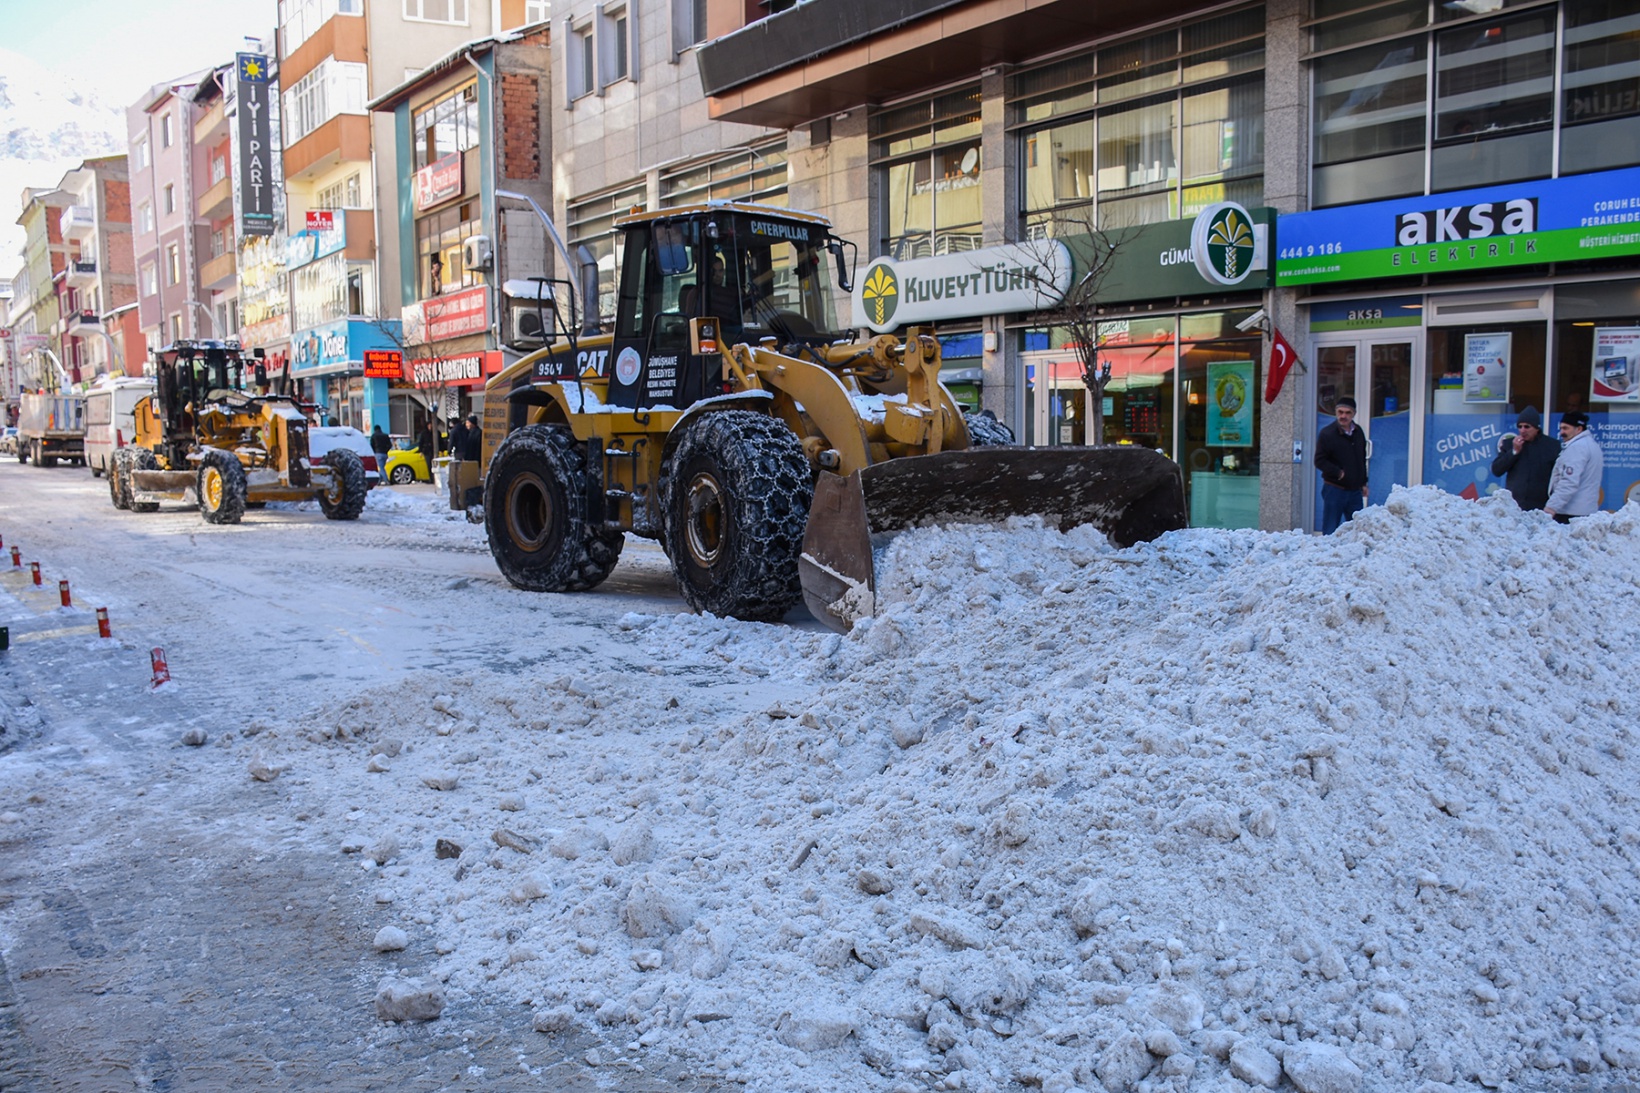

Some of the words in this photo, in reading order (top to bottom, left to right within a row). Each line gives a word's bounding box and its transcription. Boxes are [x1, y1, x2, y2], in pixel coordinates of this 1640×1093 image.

[249, 140, 263, 212] PARTİ
[1594, 199, 1628, 214] ÇORUH
[1398, 198, 1534, 247] aksa
[1581, 212, 1640, 227] PERAKENDE
[750, 220, 809, 241] CATERPILLAR
[1280, 246, 1303, 259] 444
[1307, 245, 1314, 257] 9
[1319, 242, 1342, 255] 186
[1579, 233, 1610, 249] MÜŞTERİ
[1393, 239, 1537, 267] ELEKTRİK
[1348, 308, 1382, 321] aksa
[372, 361, 399, 369] TELEFON
[576, 350, 609, 377] CAT
[649, 368, 676, 379] BELEDİYESİ
[1436, 423, 1501, 453] GÜNCEL
[1440, 444, 1491, 472] KALIN!
